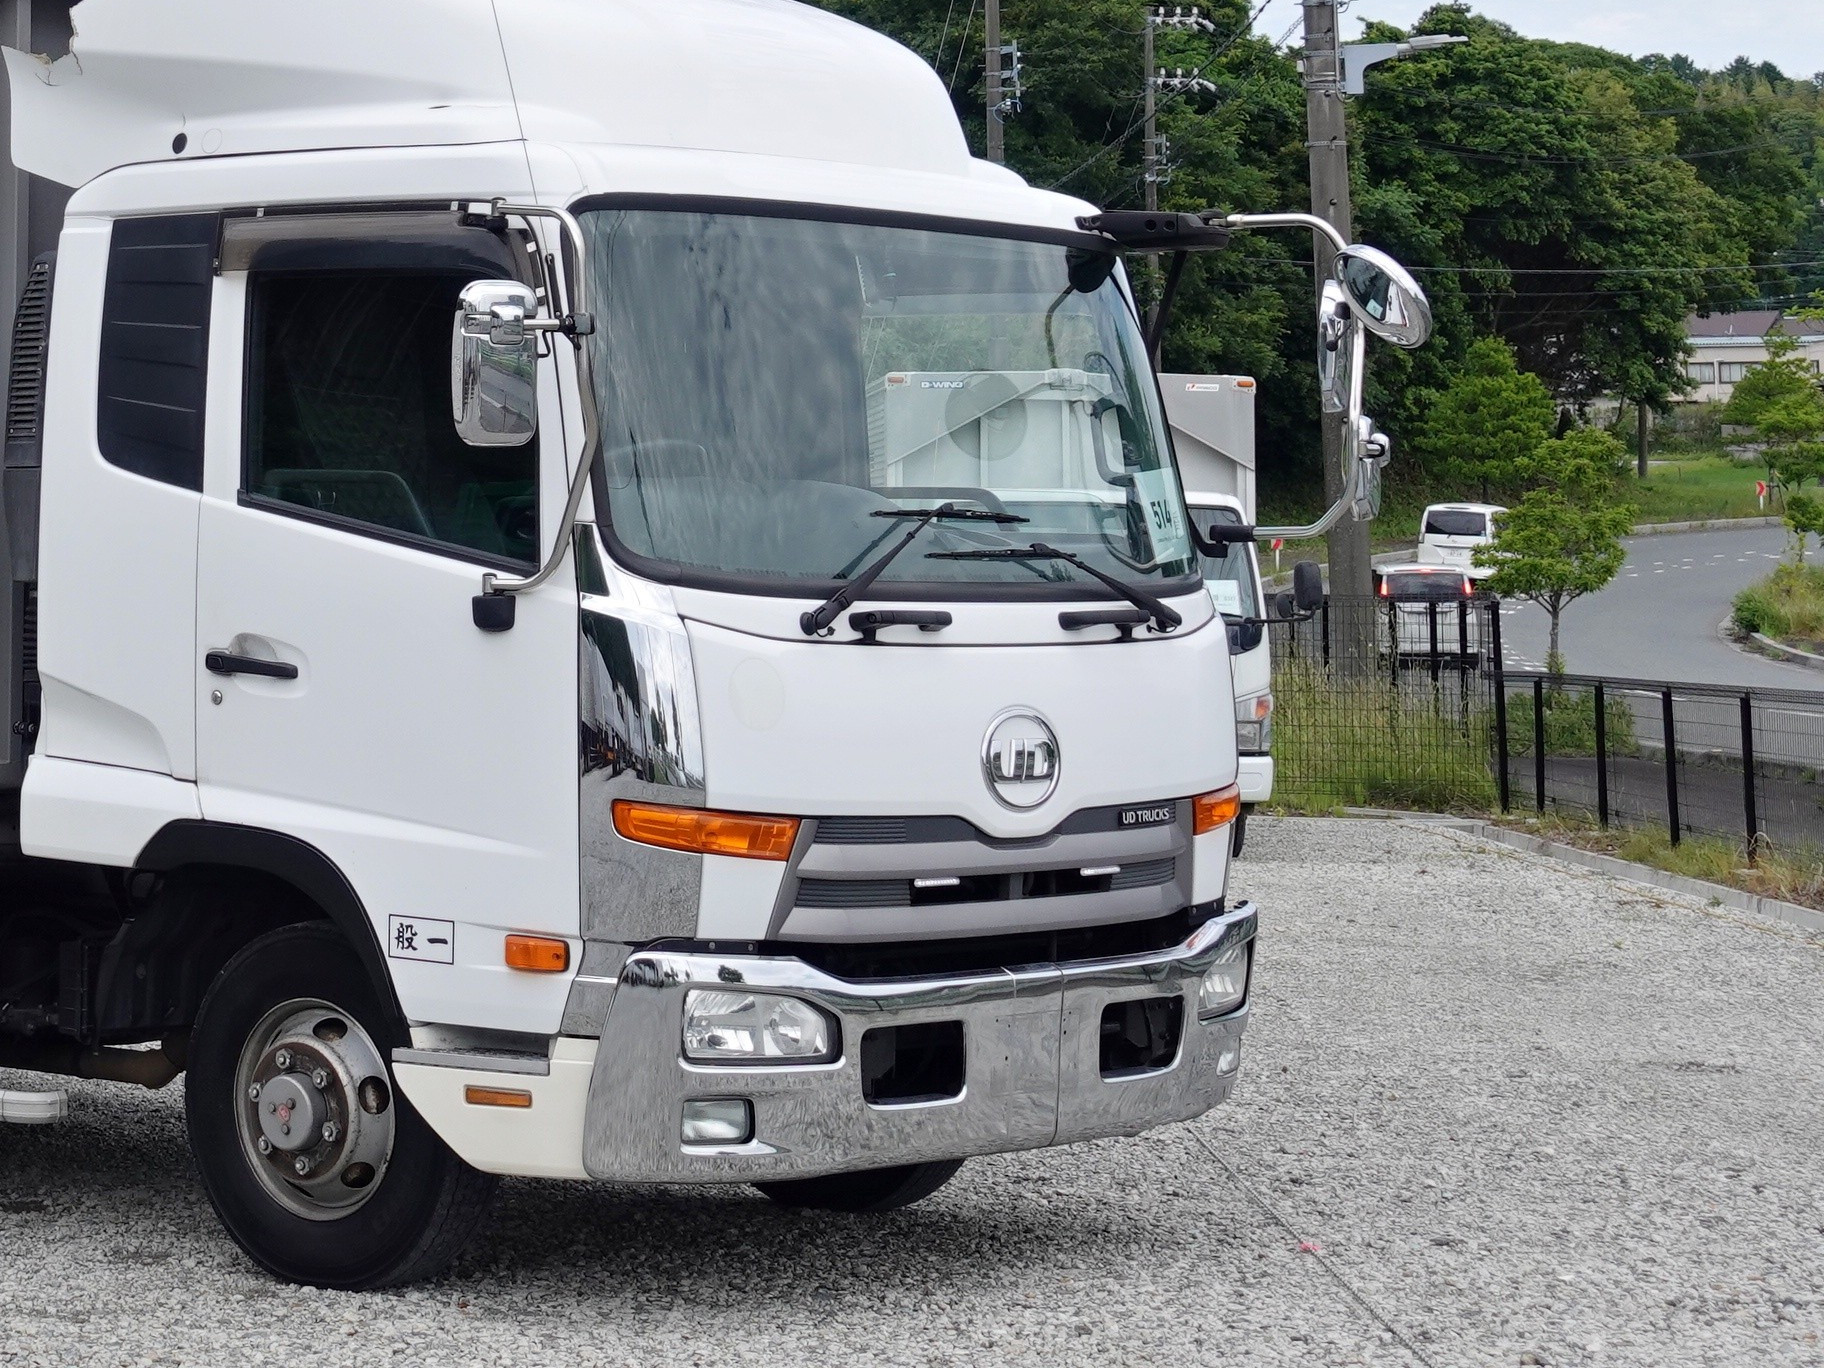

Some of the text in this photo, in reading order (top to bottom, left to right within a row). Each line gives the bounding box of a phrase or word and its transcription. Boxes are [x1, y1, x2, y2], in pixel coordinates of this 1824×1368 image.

[1150, 500, 1172, 530] 514
[990, 738, 1054, 784] UD
[1122, 808, 1170, 824] UD TRUCKS
